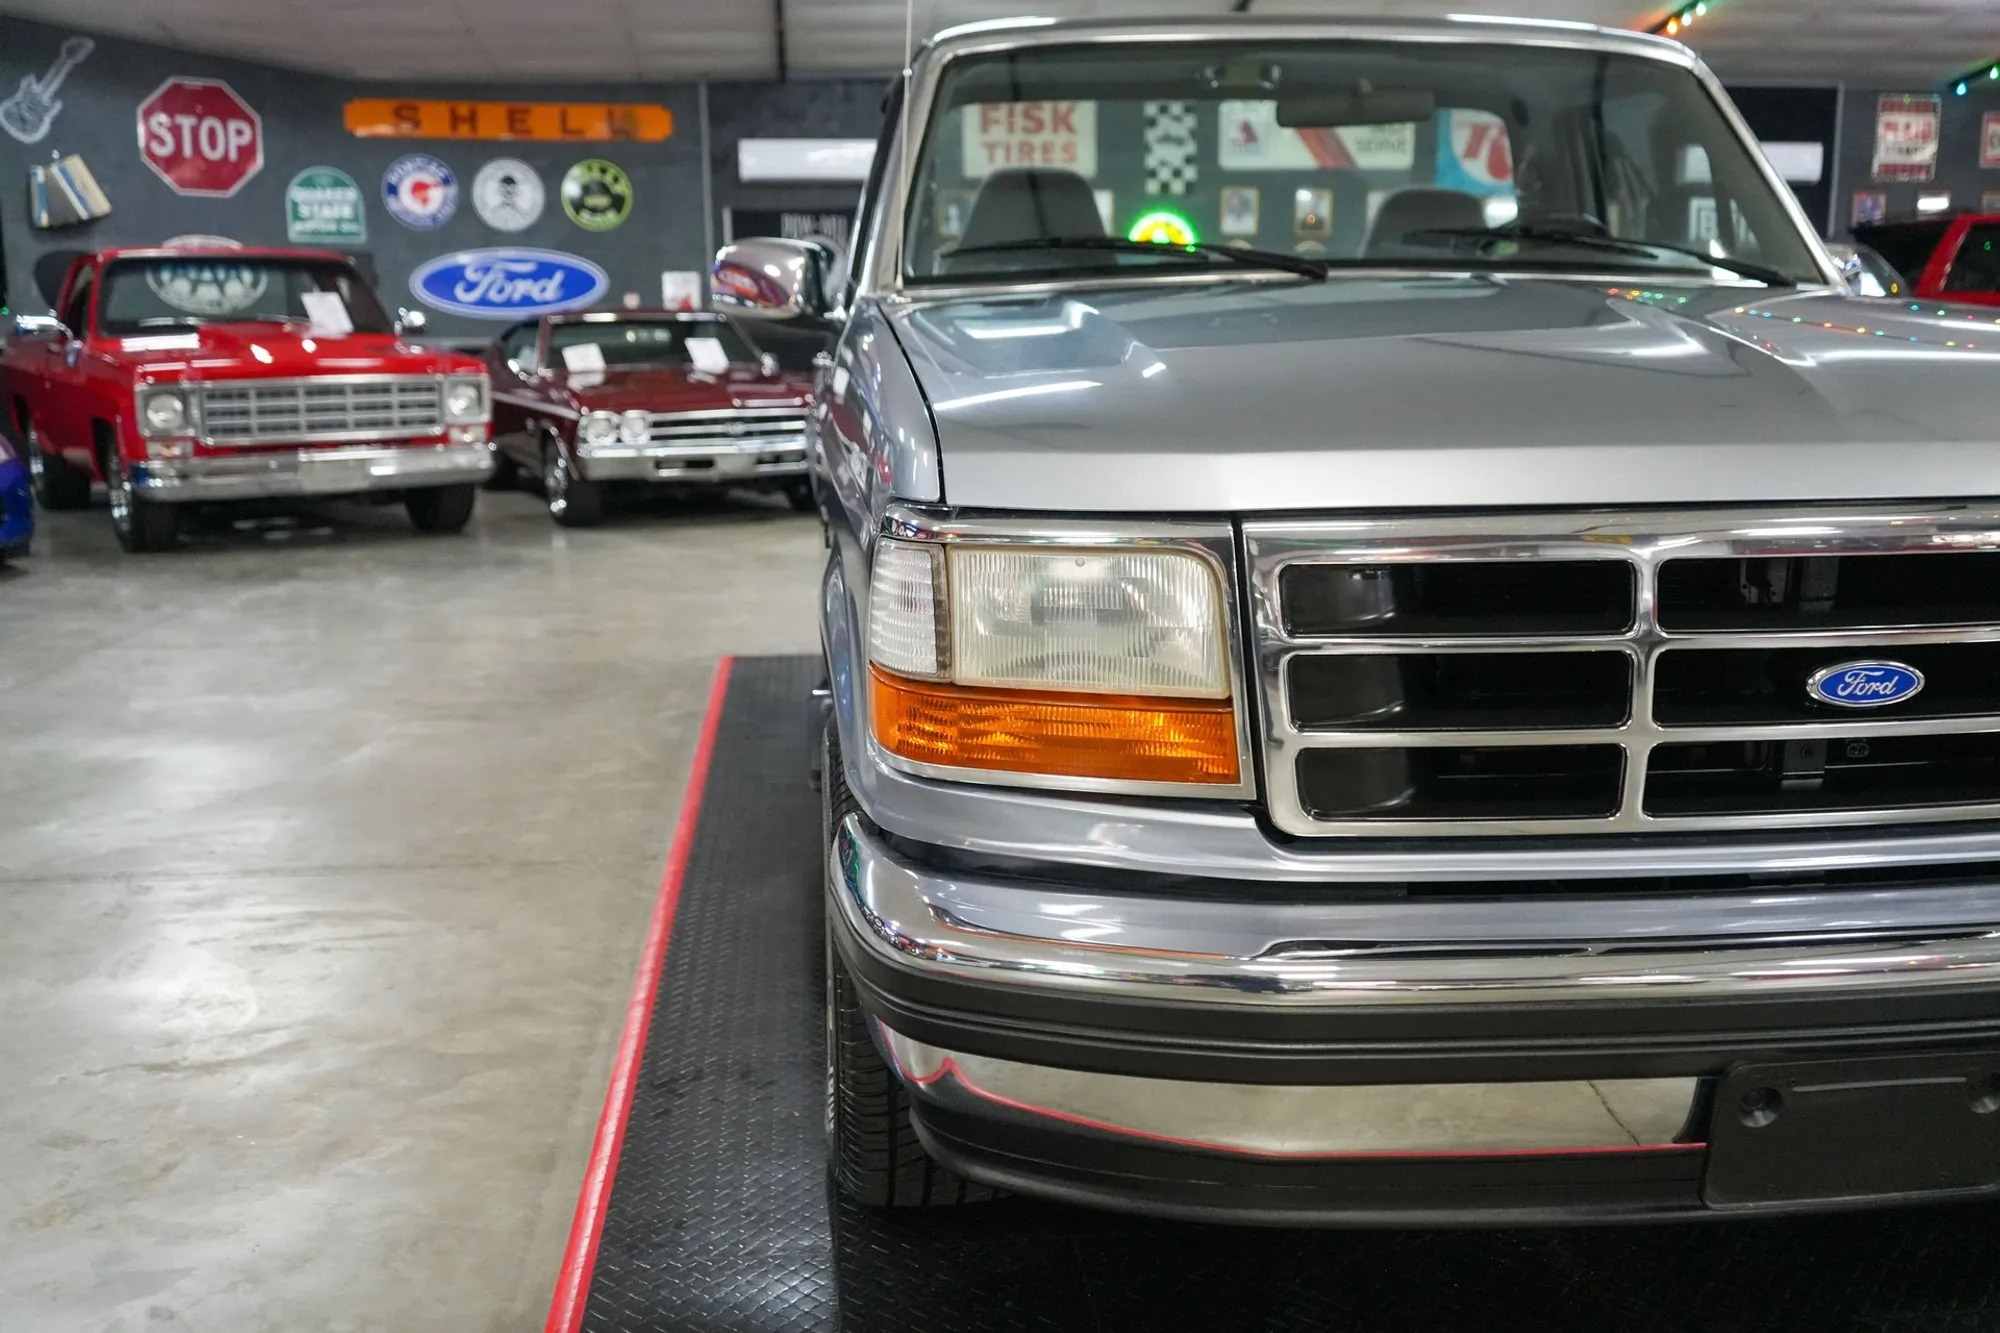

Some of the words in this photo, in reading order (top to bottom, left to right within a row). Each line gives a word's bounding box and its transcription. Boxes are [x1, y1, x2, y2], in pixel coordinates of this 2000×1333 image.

[391, 103, 633, 141] SHELL
[981, 101, 1077, 134] FISK
[149, 111, 254, 161] STOP
[983, 141, 1078, 163] TIRES
[453, 258, 566, 304] Ford
[1837, 670, 1899, 696] Ford
